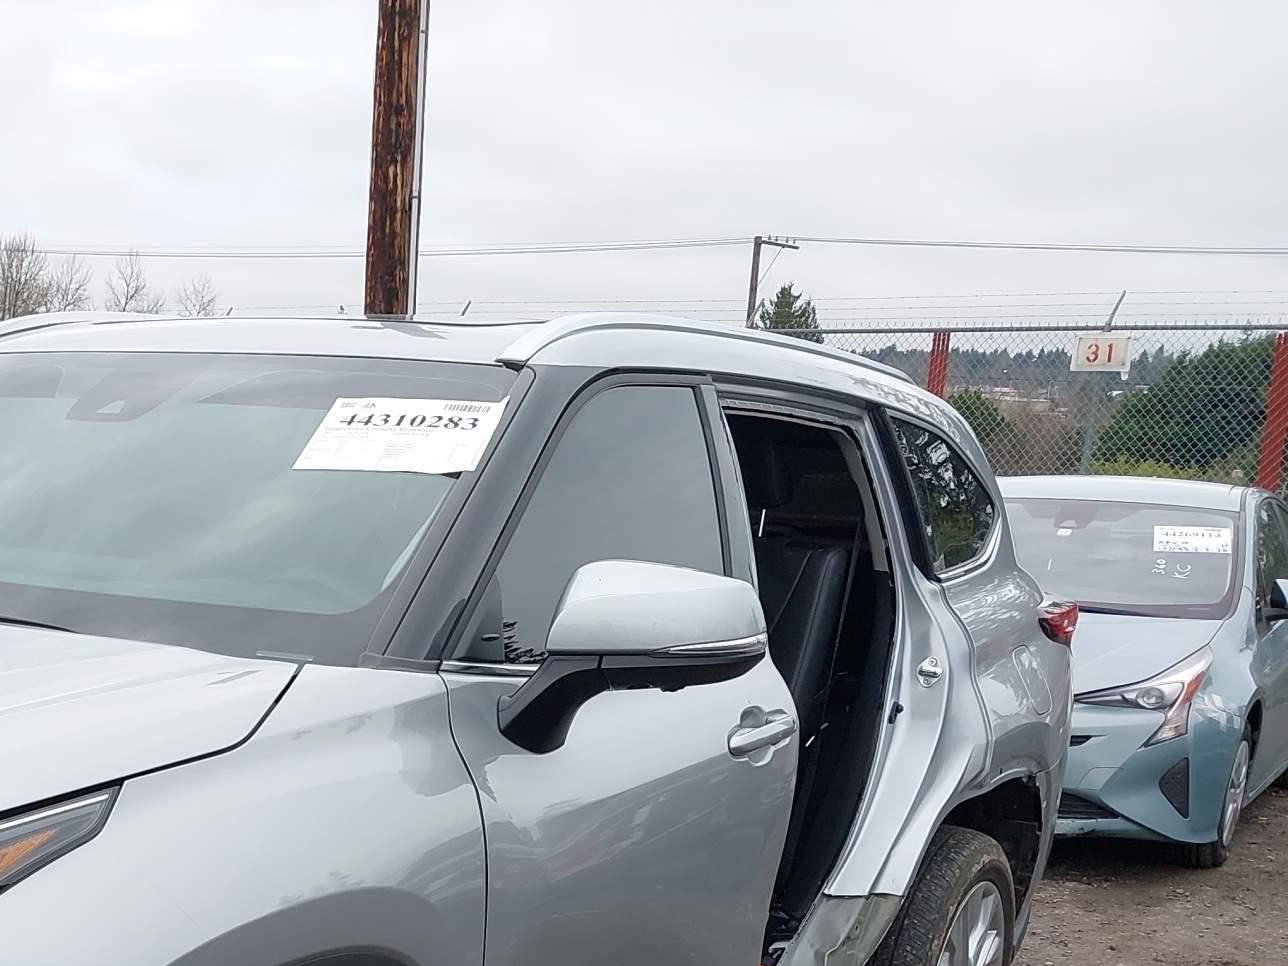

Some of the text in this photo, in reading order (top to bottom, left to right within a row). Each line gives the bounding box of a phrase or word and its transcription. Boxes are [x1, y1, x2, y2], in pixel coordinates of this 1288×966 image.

[1086, 343, 1113, 363] 31
[339, 413, 480, 431] 44310283
[1171, 563, 1192, 580] KC
